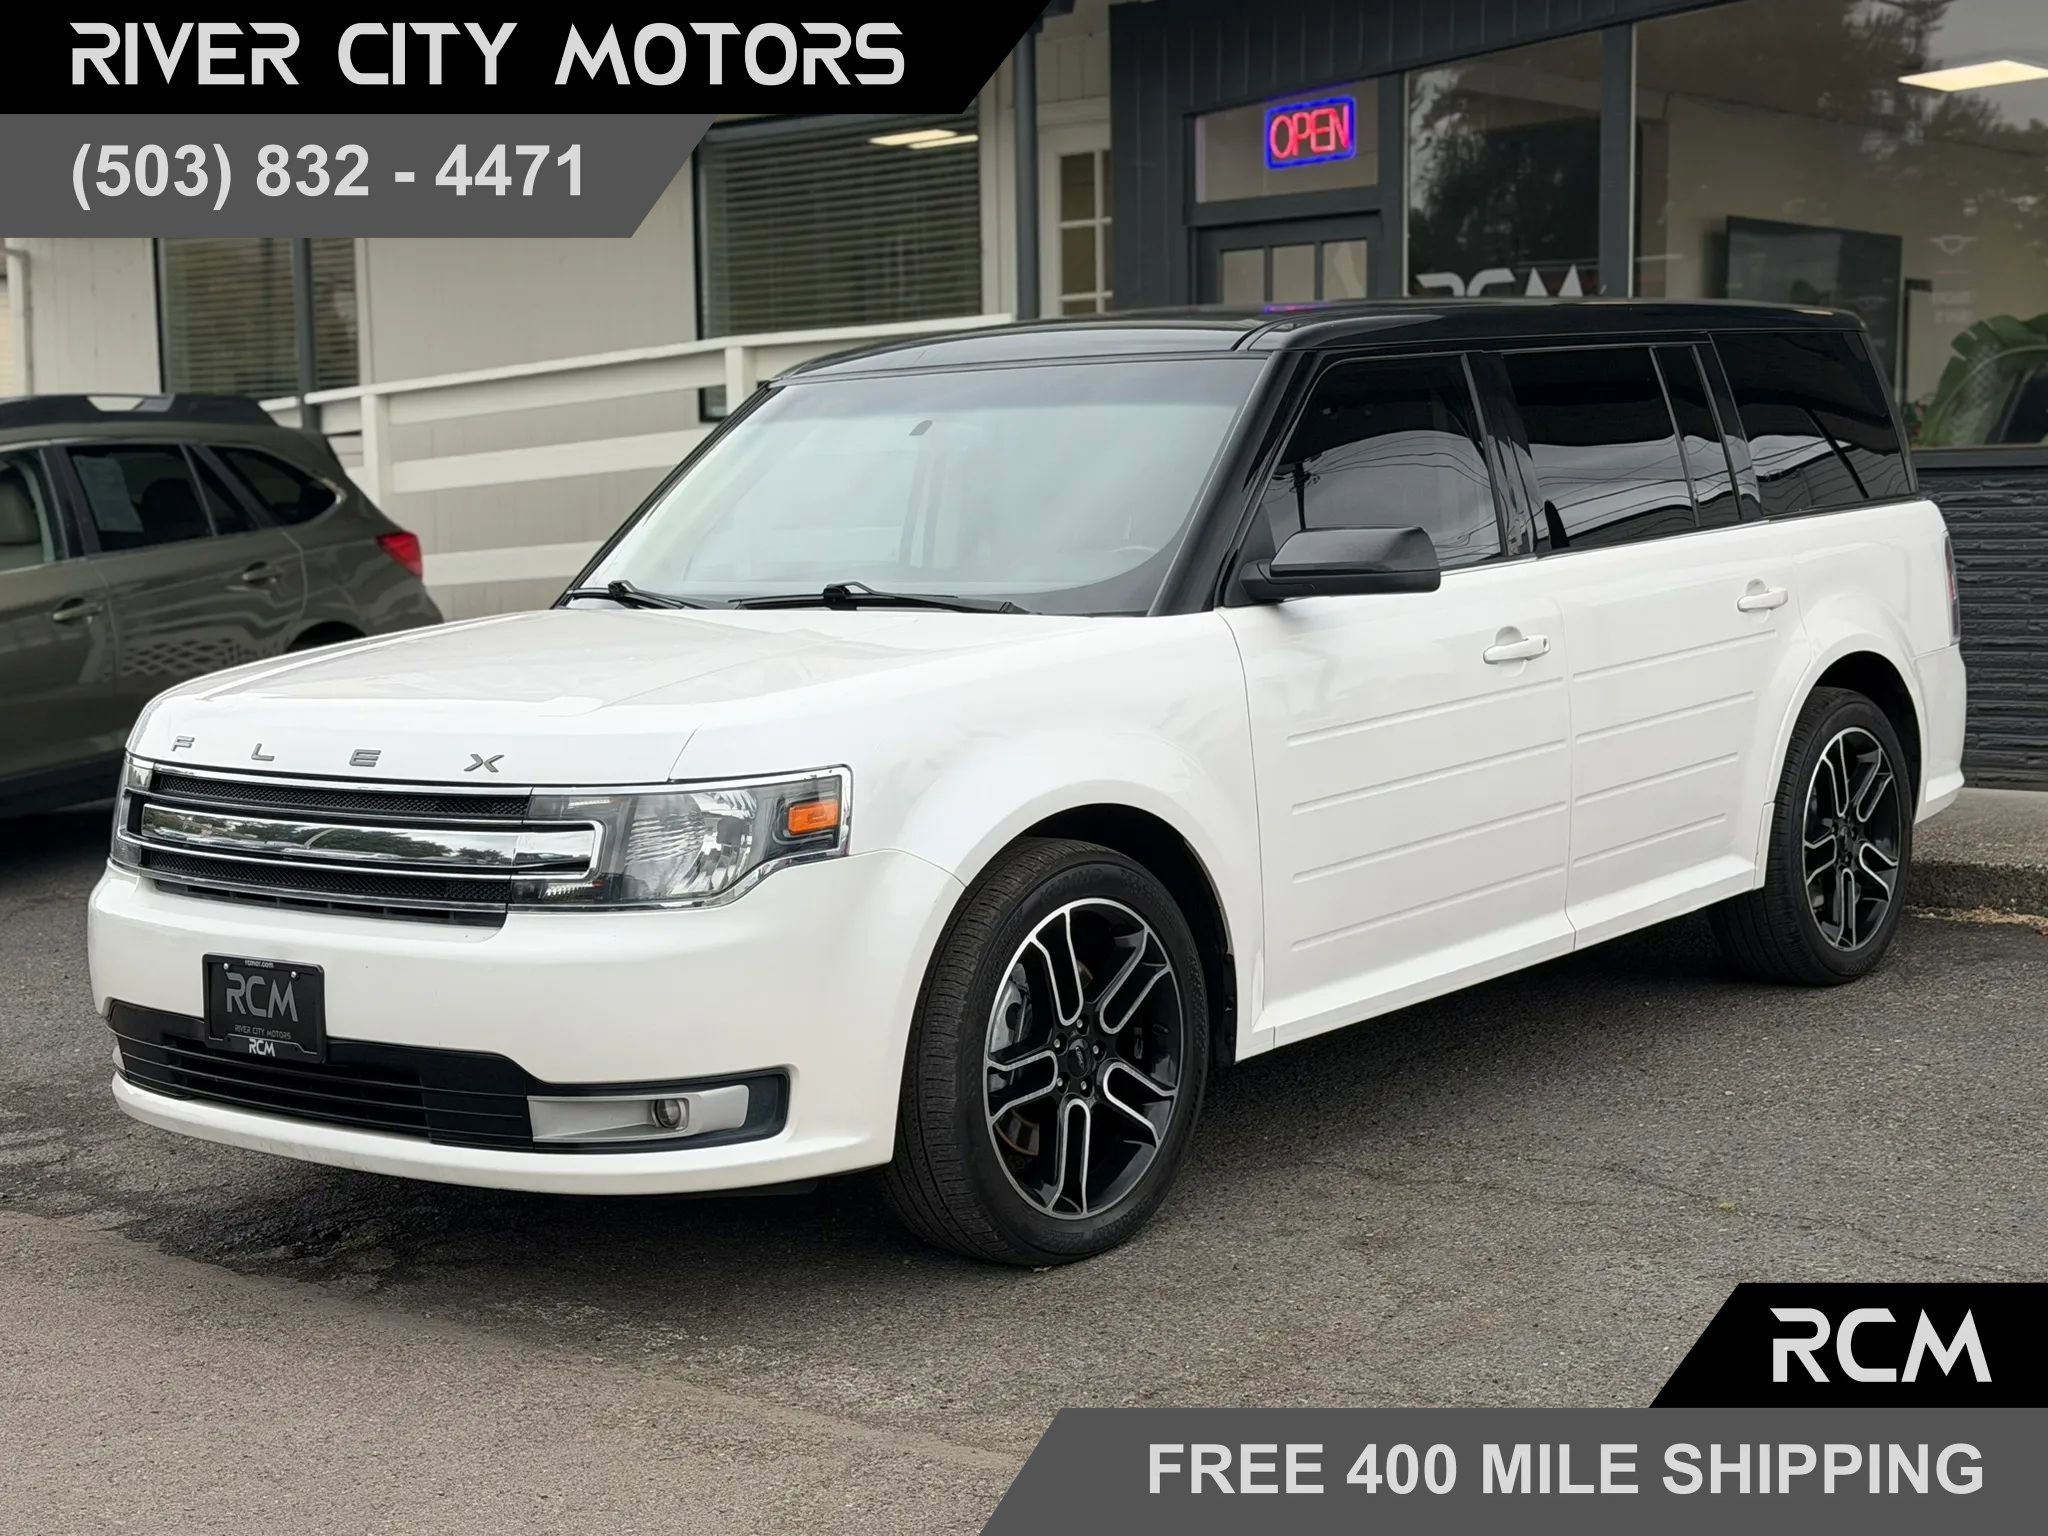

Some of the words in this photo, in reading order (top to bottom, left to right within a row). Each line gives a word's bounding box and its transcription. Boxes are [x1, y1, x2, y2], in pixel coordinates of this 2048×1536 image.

[1270, 104, 1350, 159] OPEN
[171, 735, 505, 772] FLEX
[225, 972, 299, 1022] RCM
[234, 1025, 251, 1034] RIVER
[253, 1027, 265, 1036] CITY
[267, 1029, 292, 1039] MOTORS
[248, 1039, 275, 1057] RCM
